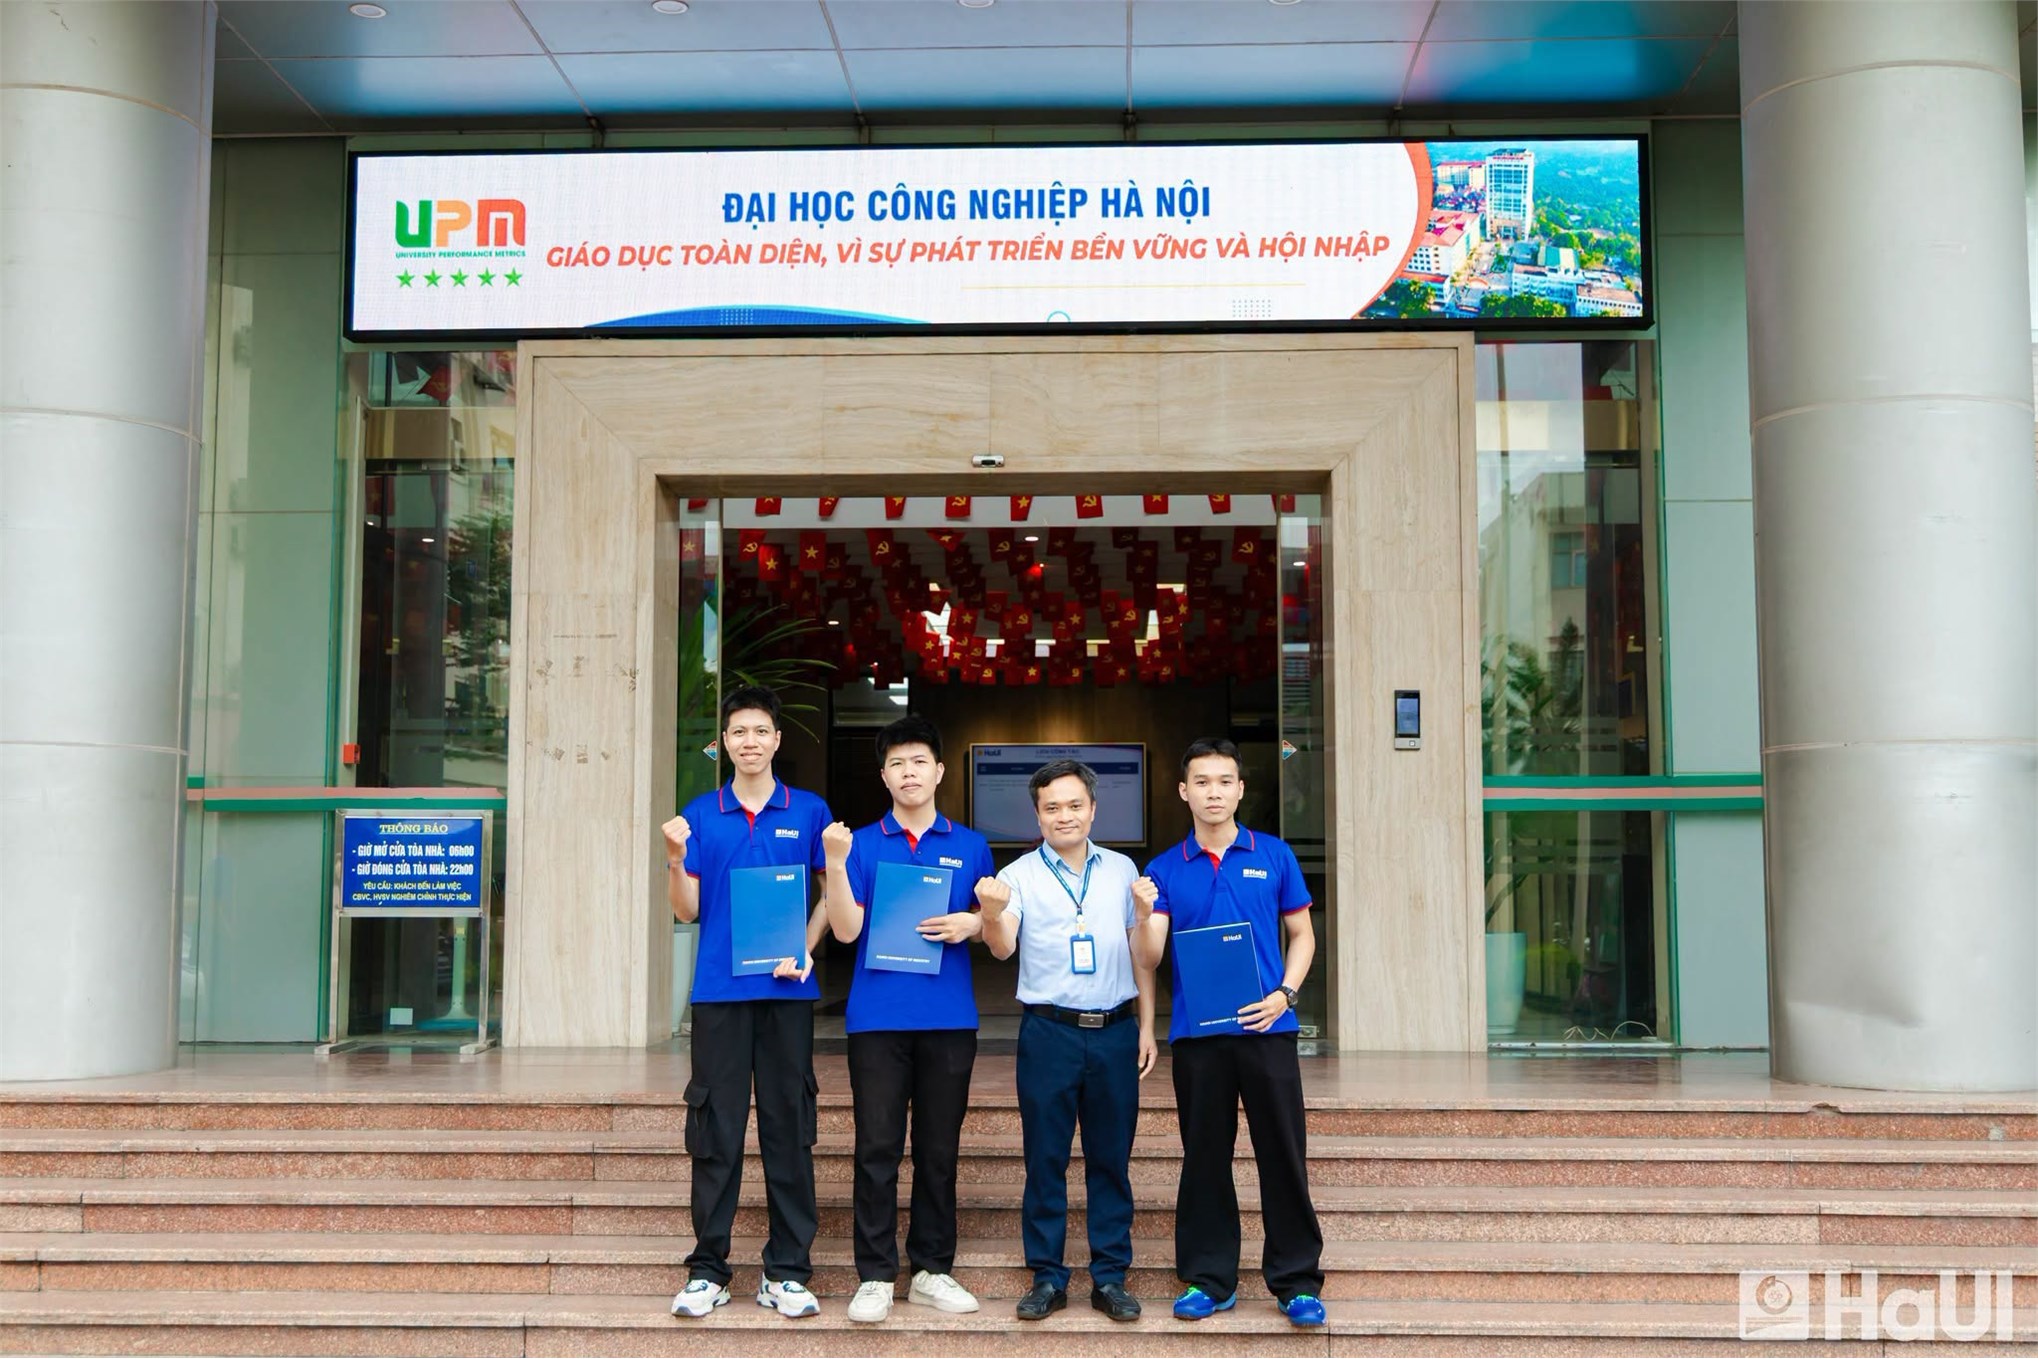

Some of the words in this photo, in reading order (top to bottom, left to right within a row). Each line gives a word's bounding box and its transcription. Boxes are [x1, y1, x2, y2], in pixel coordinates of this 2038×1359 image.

[722, 192, 776, 230] ĐẠI
[789, 191, 854, 229] HỌC
[867, 182, 957, 222] CÔNG
[968, 180, 1088, 226] NGHIỆP
[1100, 180, 1144, 219] HÀ
[1155, 180, 1210, 225] NỘI
[395, 251, 436, 259] UNIVERSITY
[438, 250, 493, 258] PERFORMANCE
[494, 249, 526, 257] METRICS
[546, 242, 611, 268] GIÁO
[617, 244, 673, 272] DỤC
[681, 238, 753, 266] TOÀN
[759, 238, 828, 268] DIỆN,
[837, 240, 863, 264] VÌ
[868, 240, 907, 270] SỰ
[909, 237, 982, 263] PHÁT
[988, 233, 1064, 261] TRIỂN
[1070, 232, 1126, 261] BỀN
[1133, 233, 1208, 260] VỮNG
[1216, 232, 1250, 259] VÀ
[1259, 231, 1307, 261] HỘI
[1313, 230, 1391, 258] NHẬP
[379, 822, 421, 834] THÔNG
[423, 822, 449, 834] BÁO
[357, 843, 373, 857] GIỜ
[374, 841, 387, 857] MỞ
[389, 841, 406, 857] CỬA
[407, 843, 424, 857] TÒA
[425, 843, 445, 857] NHÀ:
[449, 845, 475, 857] 06h00
[357, 861, 371, 875] GIỜ
[371, 861, 394, 875] ĐÓNG
[395, 859, 411, 875] CỬA
[412, 861, 428, 875] TÒA
[429, 861, 448, 875] NHÀ:
[449, 863, 474, 875] 22h00
